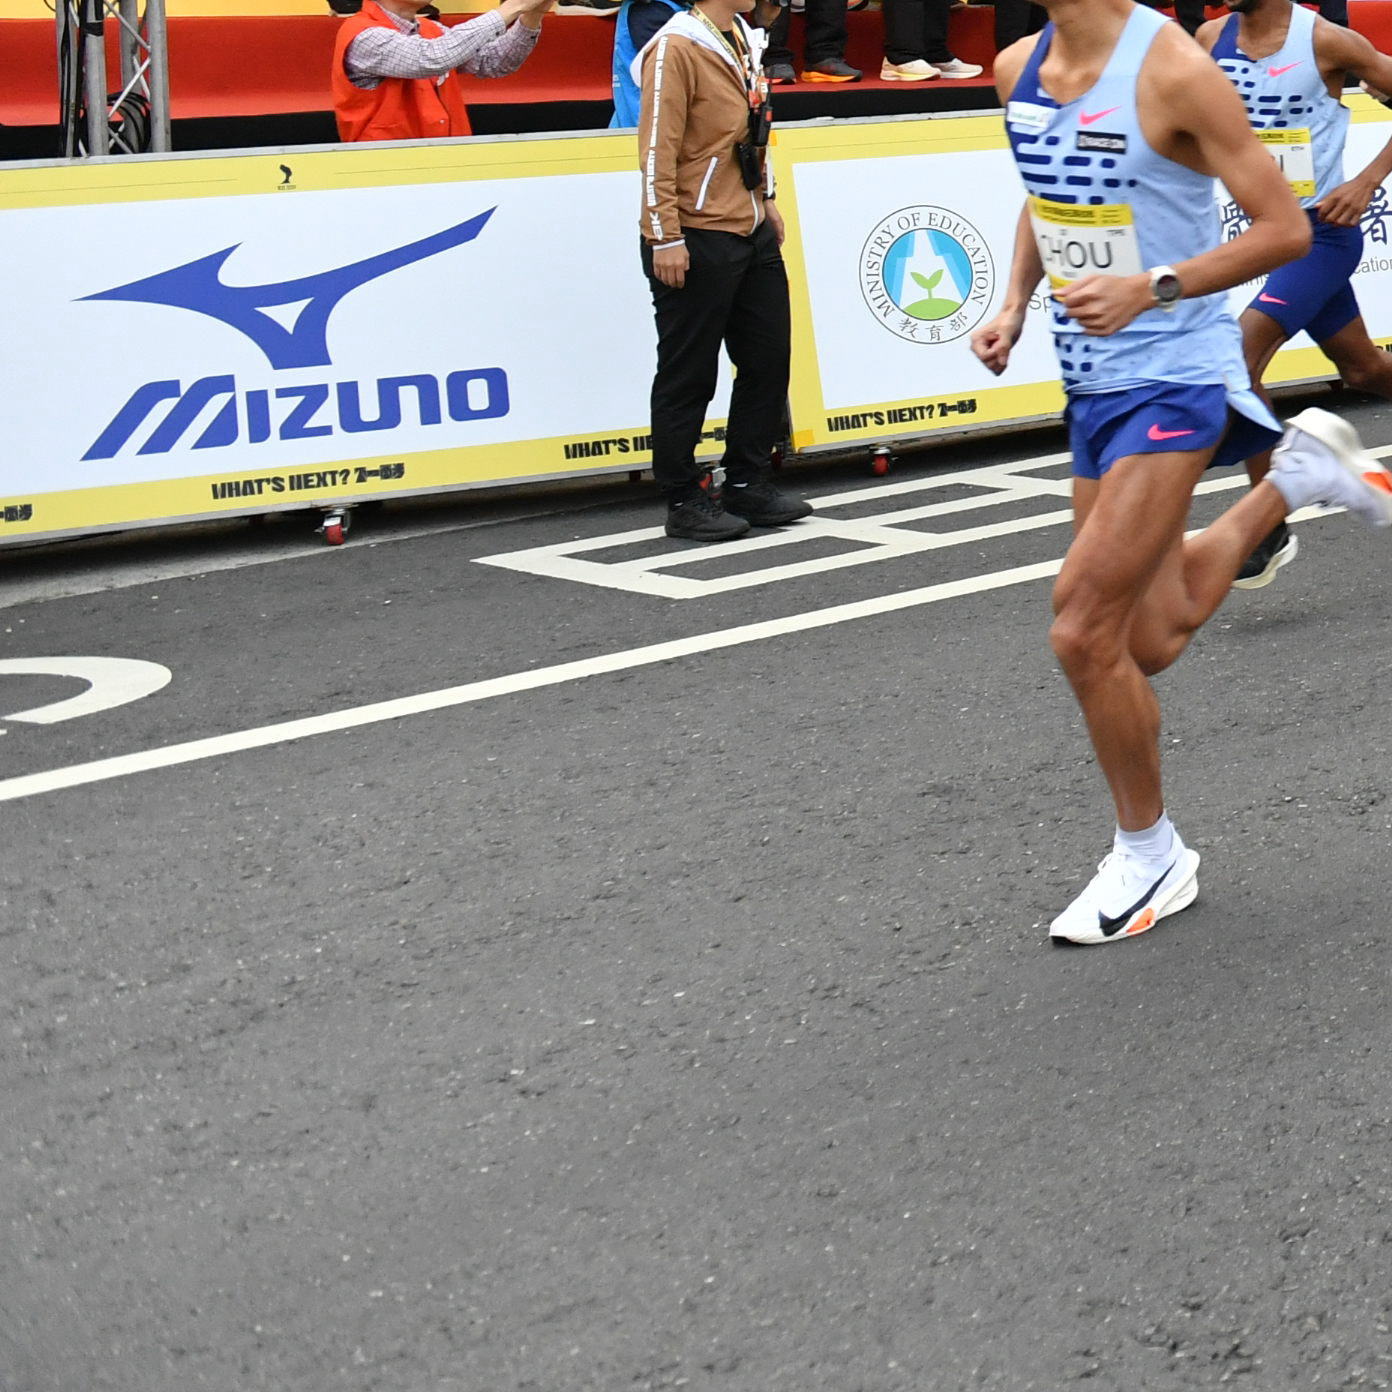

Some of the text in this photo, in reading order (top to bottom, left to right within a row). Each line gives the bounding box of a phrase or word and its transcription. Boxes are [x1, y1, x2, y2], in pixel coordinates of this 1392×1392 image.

[866, 212, 990, 318] MINISTRY OF EDUCATION
[899, 310, 968, 342] 教育部
[79, 367, 511, 461] MIZUNO
[827, 410, 885, 432] WHAT'S
[887, 404, 935, 424] NEXT?
[563, 437, 630, 459] WHAT'S
[211, 476, 286, 500] WHAT'S
[288, 468, 350, 490] NEXT?
